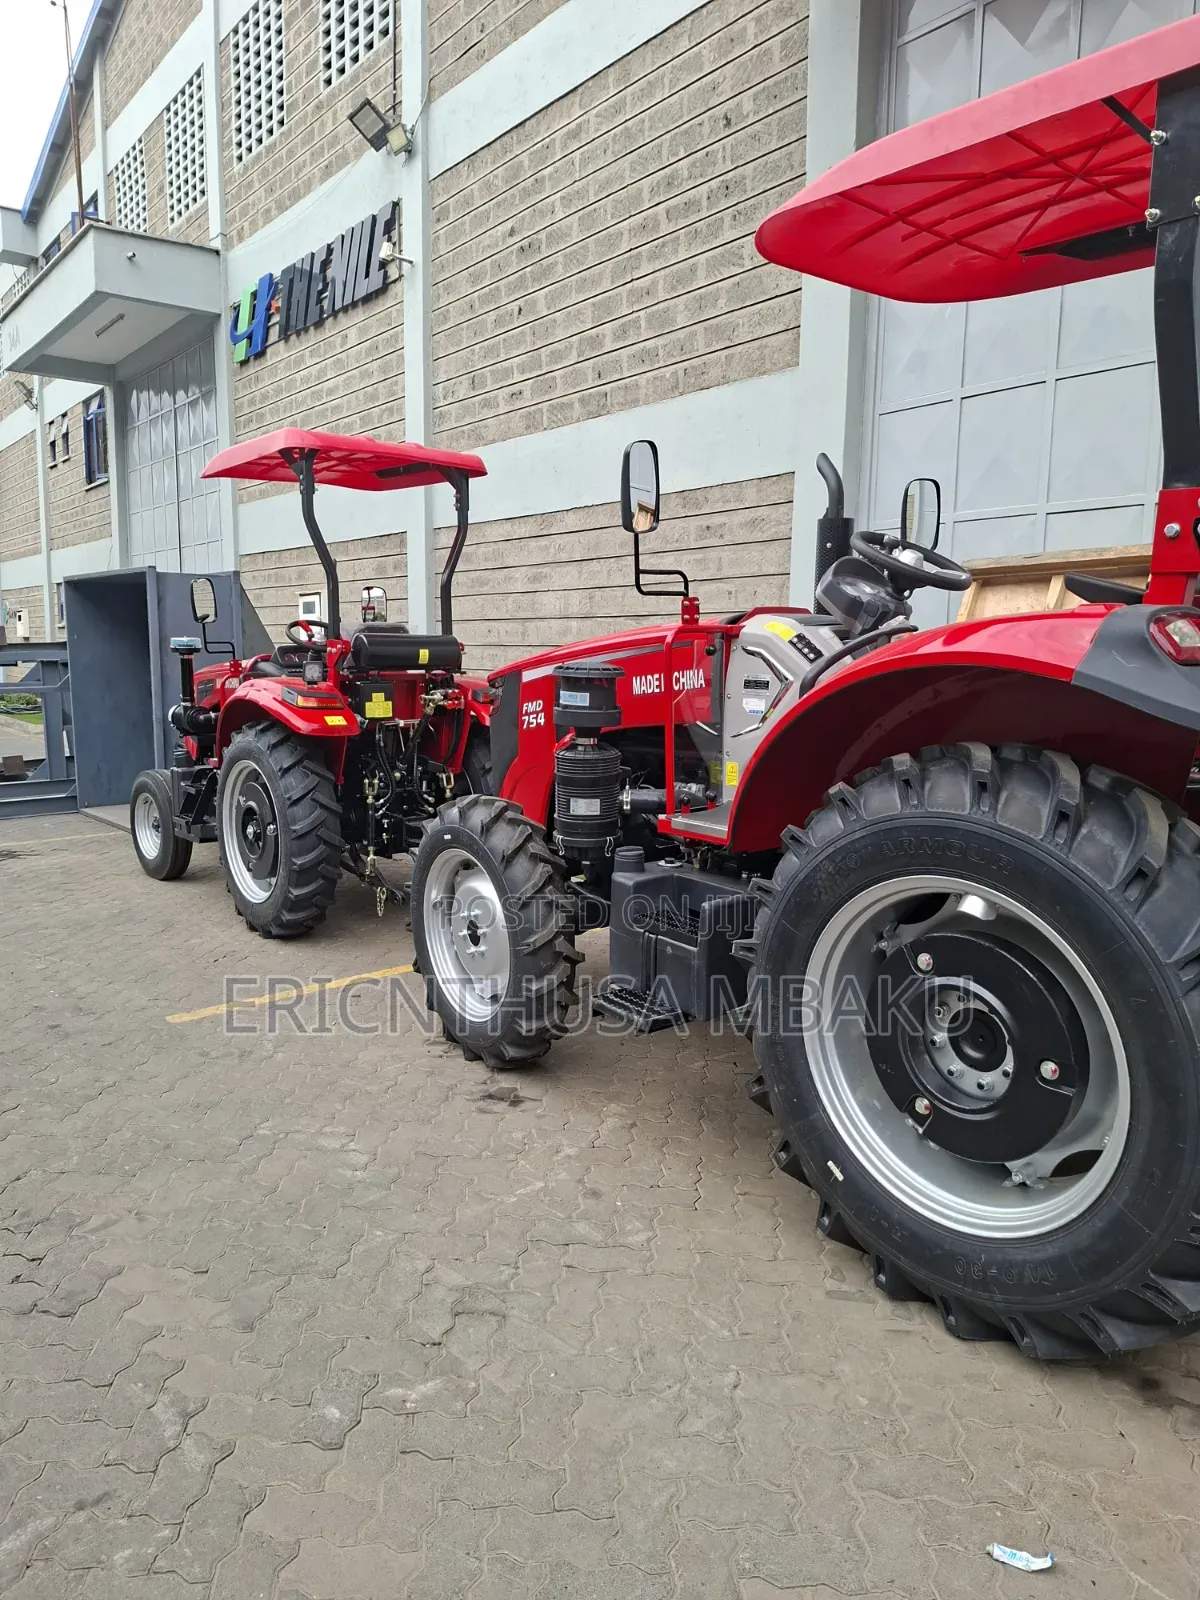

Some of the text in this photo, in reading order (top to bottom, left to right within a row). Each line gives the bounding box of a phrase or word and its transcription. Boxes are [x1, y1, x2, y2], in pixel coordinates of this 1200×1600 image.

[278, 200, 397, 338] THE NILE
[633, 674, 660, 695] MADE
[673, 668, 706, 691] CHINA
[522, 699, 543, 715] FMD
[521, 712, 545, 730] 754
[878, 836, 1015, 875] ARMOUR
